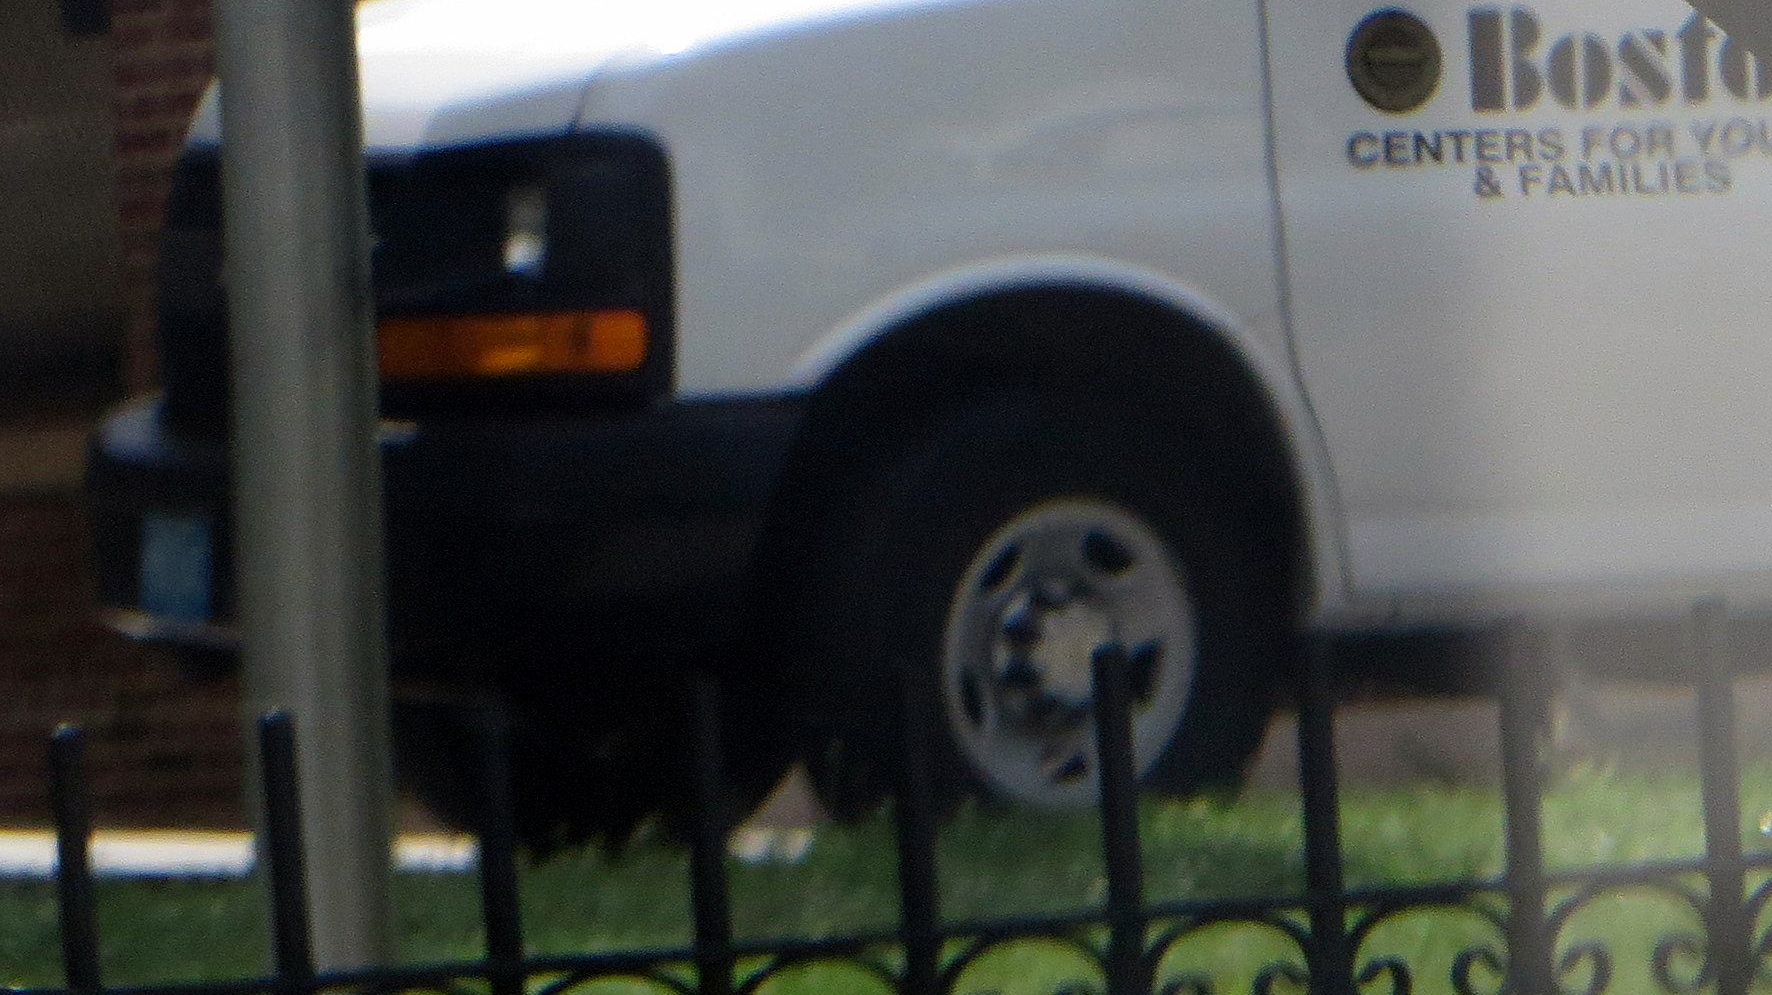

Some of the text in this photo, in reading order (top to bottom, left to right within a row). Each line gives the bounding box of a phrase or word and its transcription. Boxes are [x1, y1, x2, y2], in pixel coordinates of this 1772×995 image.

[1346, 128, 1566, 169] CENTERS
[1583, 120, 1676, 159] FOR
[1474, 159, 1734, 199] & FAMILIES
